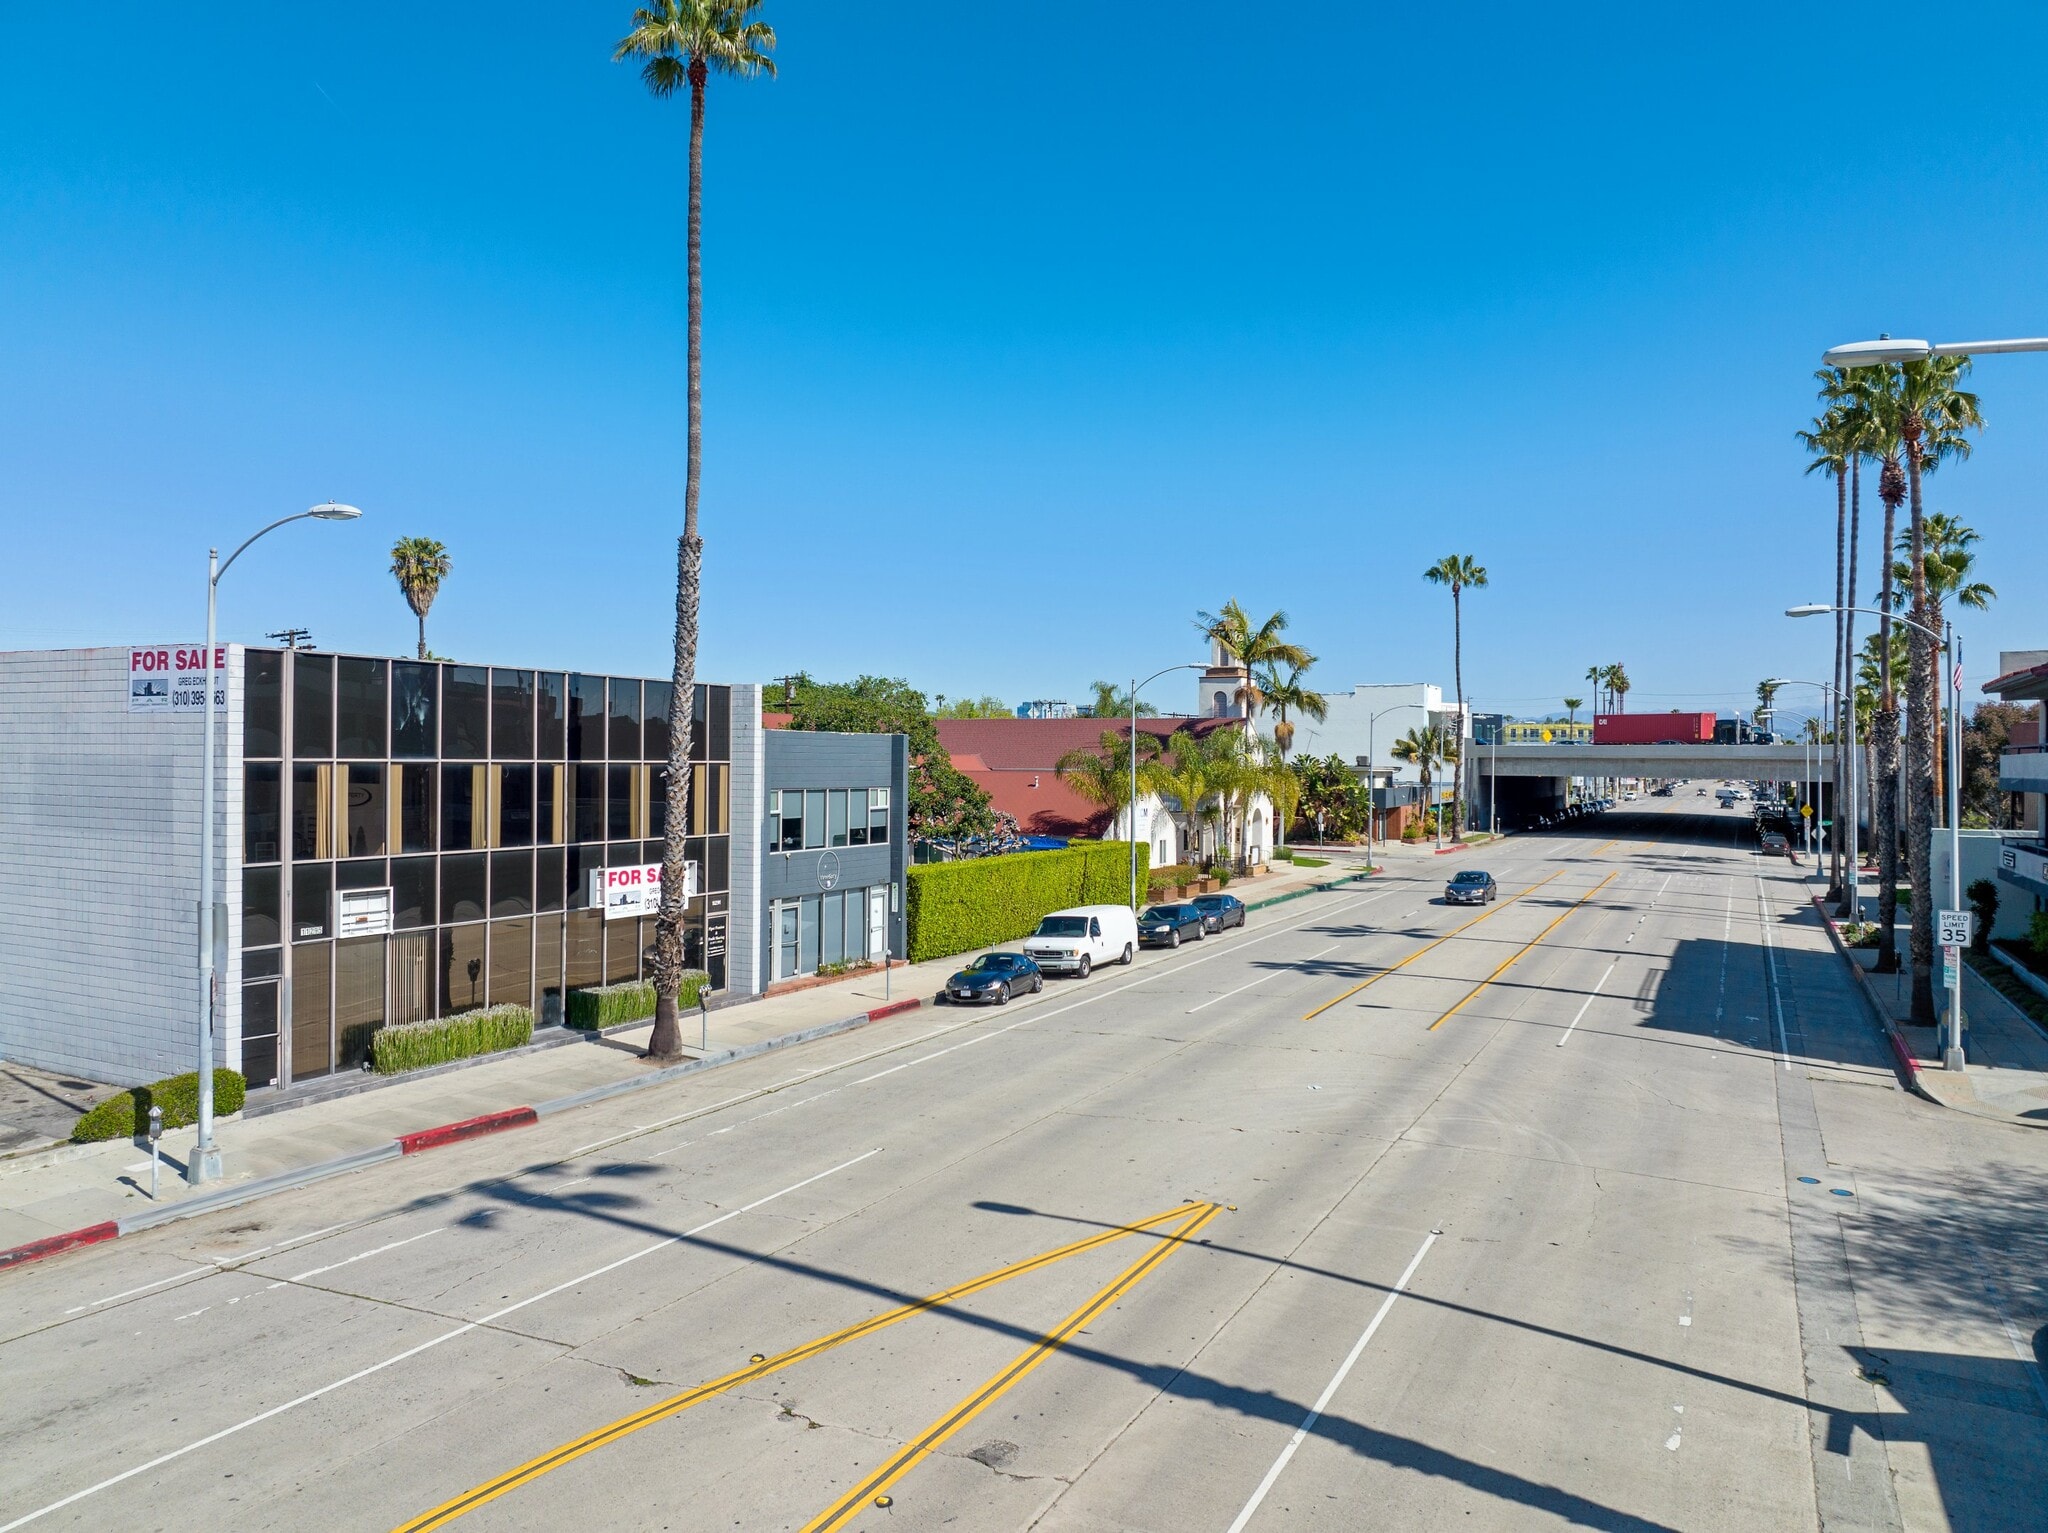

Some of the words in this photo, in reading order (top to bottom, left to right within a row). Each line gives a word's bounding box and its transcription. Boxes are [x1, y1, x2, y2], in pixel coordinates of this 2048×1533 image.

[132, 651, 169, 671] FOR
[178, 677, 192, 686] GREG
[193, 676, 219, 686] ECKHT
[172, 690, 190, 707] (310)
[191, 690, 225, 705] 395-63
[608, 869, 641, 887] FOR
[647, 867, 664, 883] SA
[1942, 929, 1967, 942] 35
